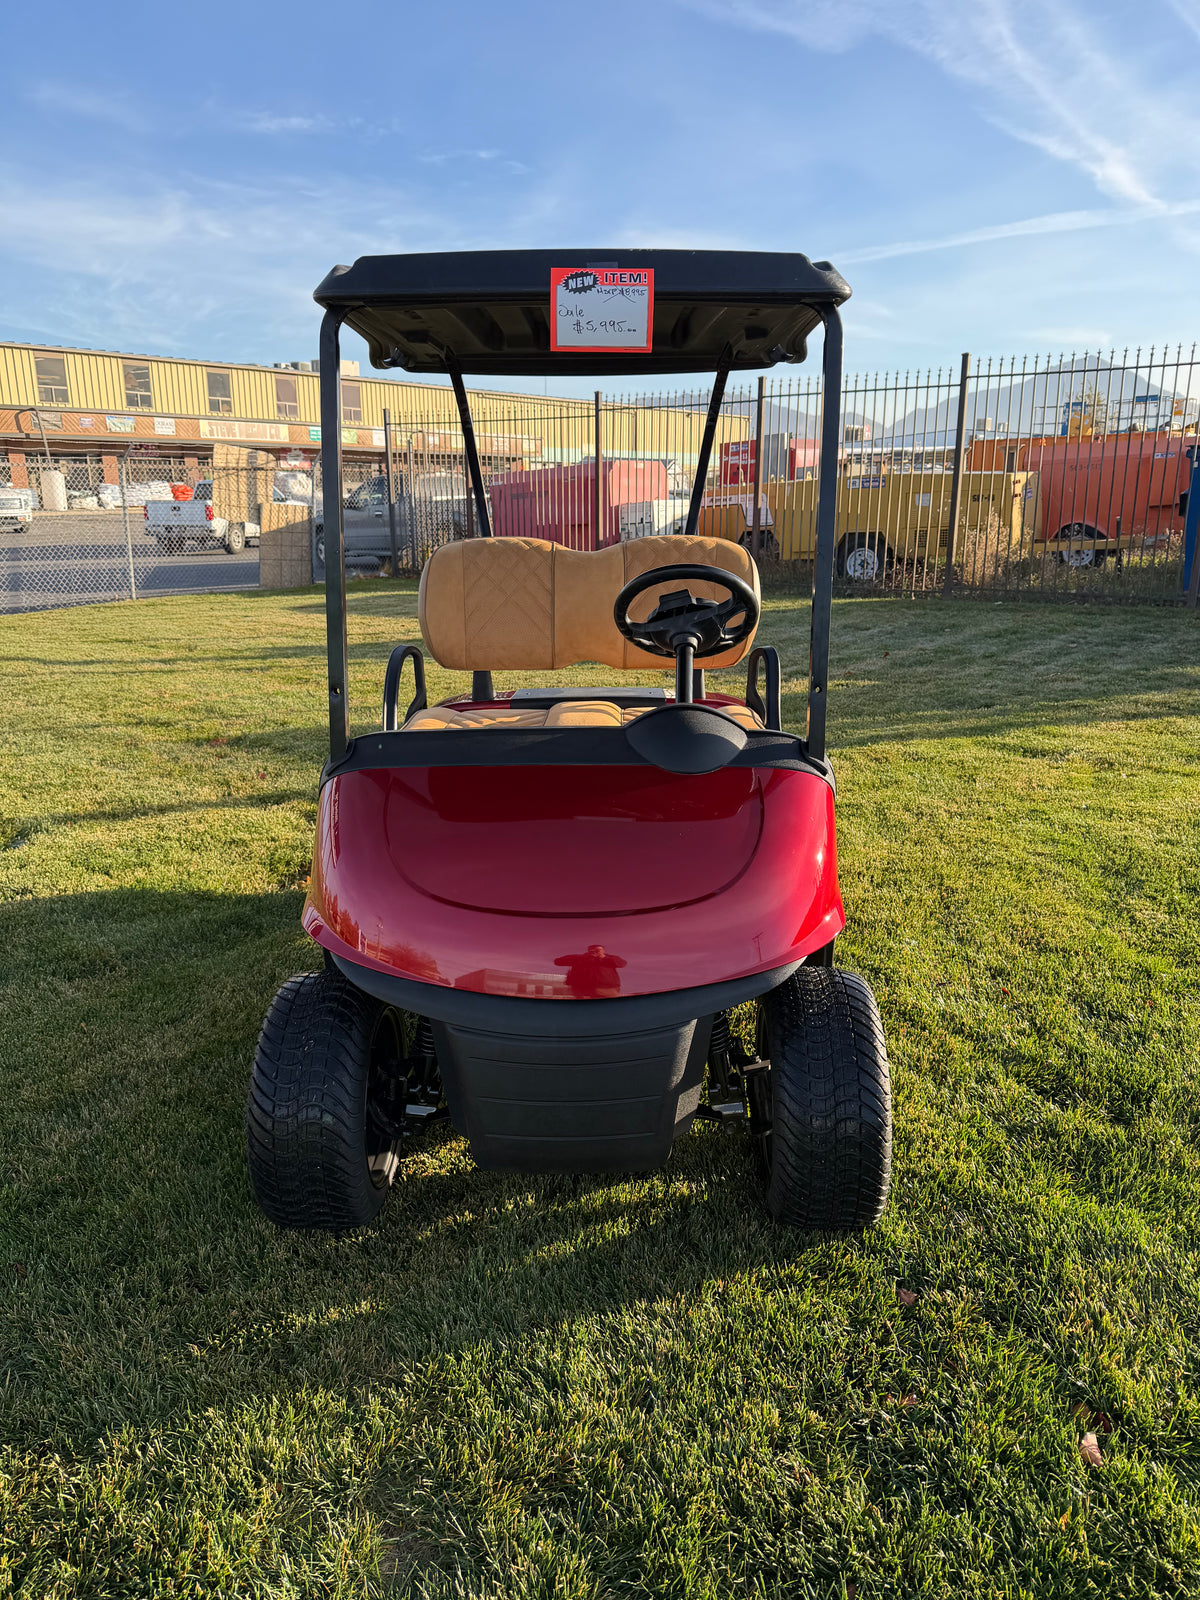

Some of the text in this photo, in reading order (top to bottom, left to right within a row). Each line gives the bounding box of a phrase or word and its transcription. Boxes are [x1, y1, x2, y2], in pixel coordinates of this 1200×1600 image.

[568, 272, 648, 290] NEW ITEM!
[559, 304, 584, 316] Sale
